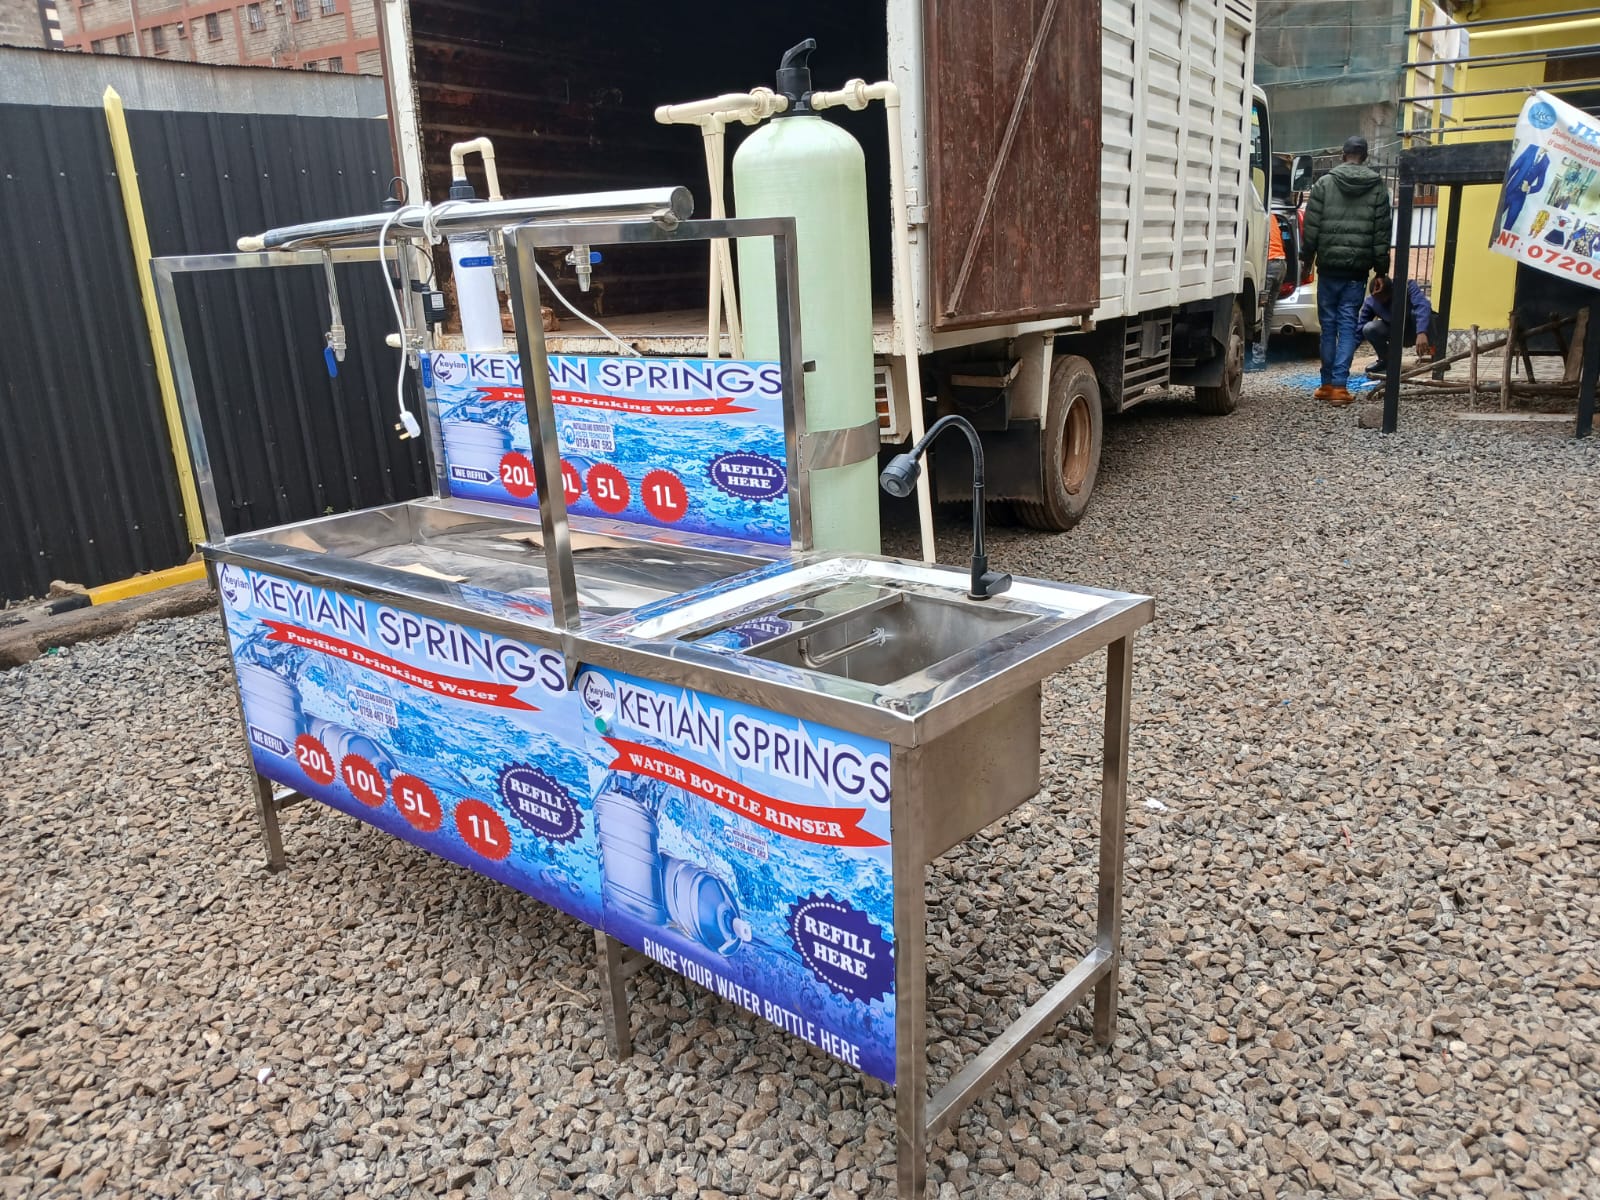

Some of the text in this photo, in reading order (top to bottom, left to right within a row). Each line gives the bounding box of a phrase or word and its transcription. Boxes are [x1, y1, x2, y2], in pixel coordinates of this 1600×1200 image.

[440, 359, 467, 370] keyian
[470, 357, 782, 395] KEYAN SPRINGS
[569, 395, 652, 413] Drinking
[656, 404, 714, 413] Water
[575, 437, 613, 451] 0758 467 582
[454, 467, 488, 481] WE REFILL
[502, 464, 534, 487] 20L
[720, 462, 777, 478] REFILL
[728, 475, 772, 489] HERE
[597, 477, 620, 501] 5L
[652, 484, 678, 509] 1L
[224, 573, 249, 591] keyian
[251, 575, 565, 692] KEYIAN SPRINGS
[286, 630, 498, 701] Purified Drinking Water
[589, 685, 616, 701] keyian
[374, 710, 384, 722] 467
[385, 713, 397, 727] 582
[253, 730, 284, 754] WE REFILL
[619, 686, 891, 804] KEYIAN SPRINGS
[298, 744, 333, 777] 20L
[345, 764, 383, 799] 10L
[509, 777, 566, 812] REFILL
[628, 752, 687, 783] WATER
[689, 772, 761, 818] BOTTLE
[764, 807, 845, 839] RINSER
[402, 787, 431, 819] 5L
[518, 797, 562, 827] HERE
[468, 815, 498, 846] 1L
[804, 914, 876, 960] REFILL
[813, 941, 868, 980] HERE
[643, 936, 861, 1070] RINSE YOUR WATER BOTTLE HERE
